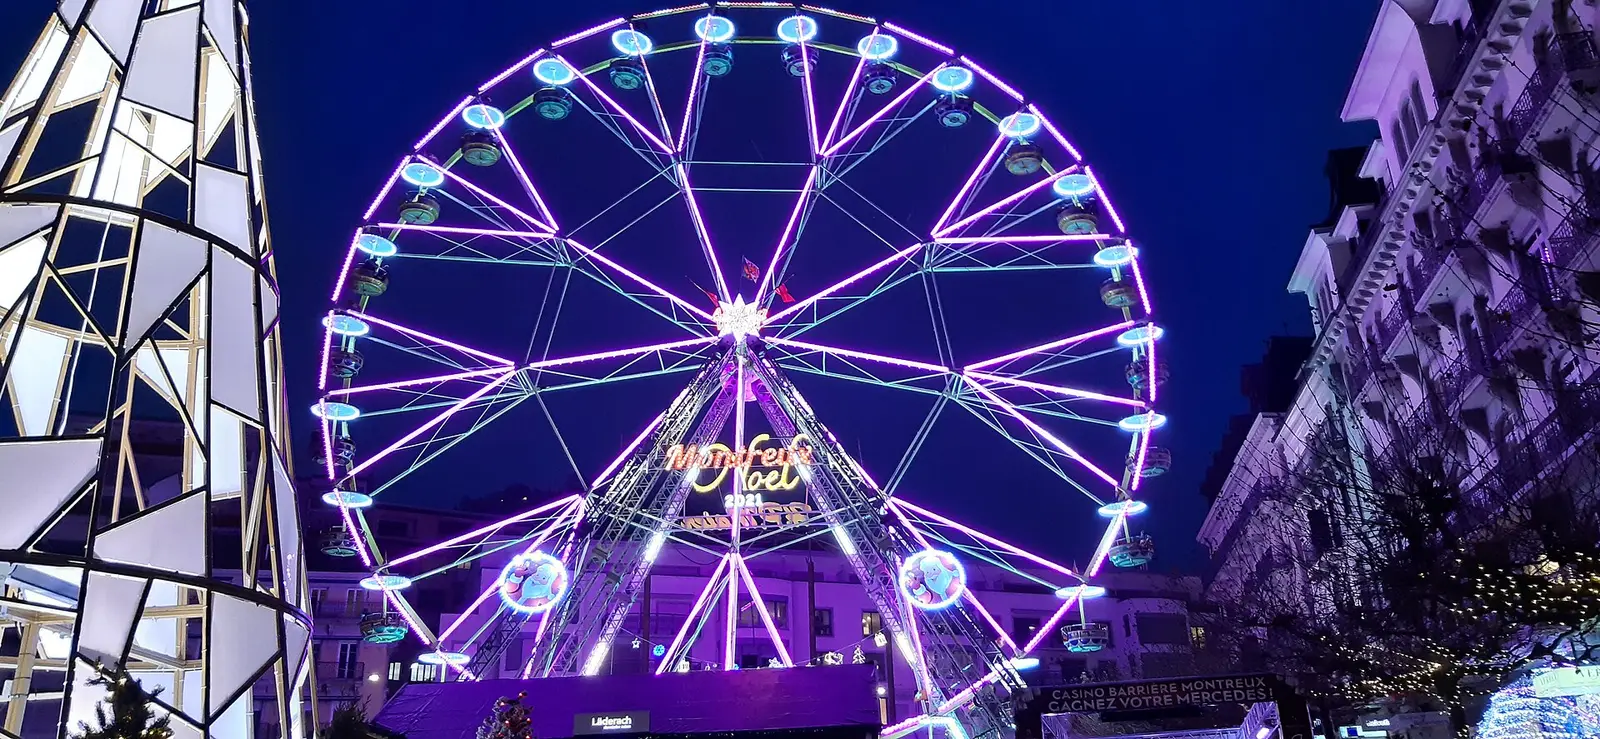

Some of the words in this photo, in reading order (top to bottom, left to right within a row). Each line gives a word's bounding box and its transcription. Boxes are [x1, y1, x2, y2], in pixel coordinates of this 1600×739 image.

[724, 493, 763, 508] 2021
[1052, 688, 1105, 700] CASINO
[1109, 683, 1178, 697] BARRIÈRE
[1182, 677, 1266, 691] MONTREUX
[1048, 698, 1117, 712] GAGNEZ
[1120, 694, 1173, 708] VOTRE
